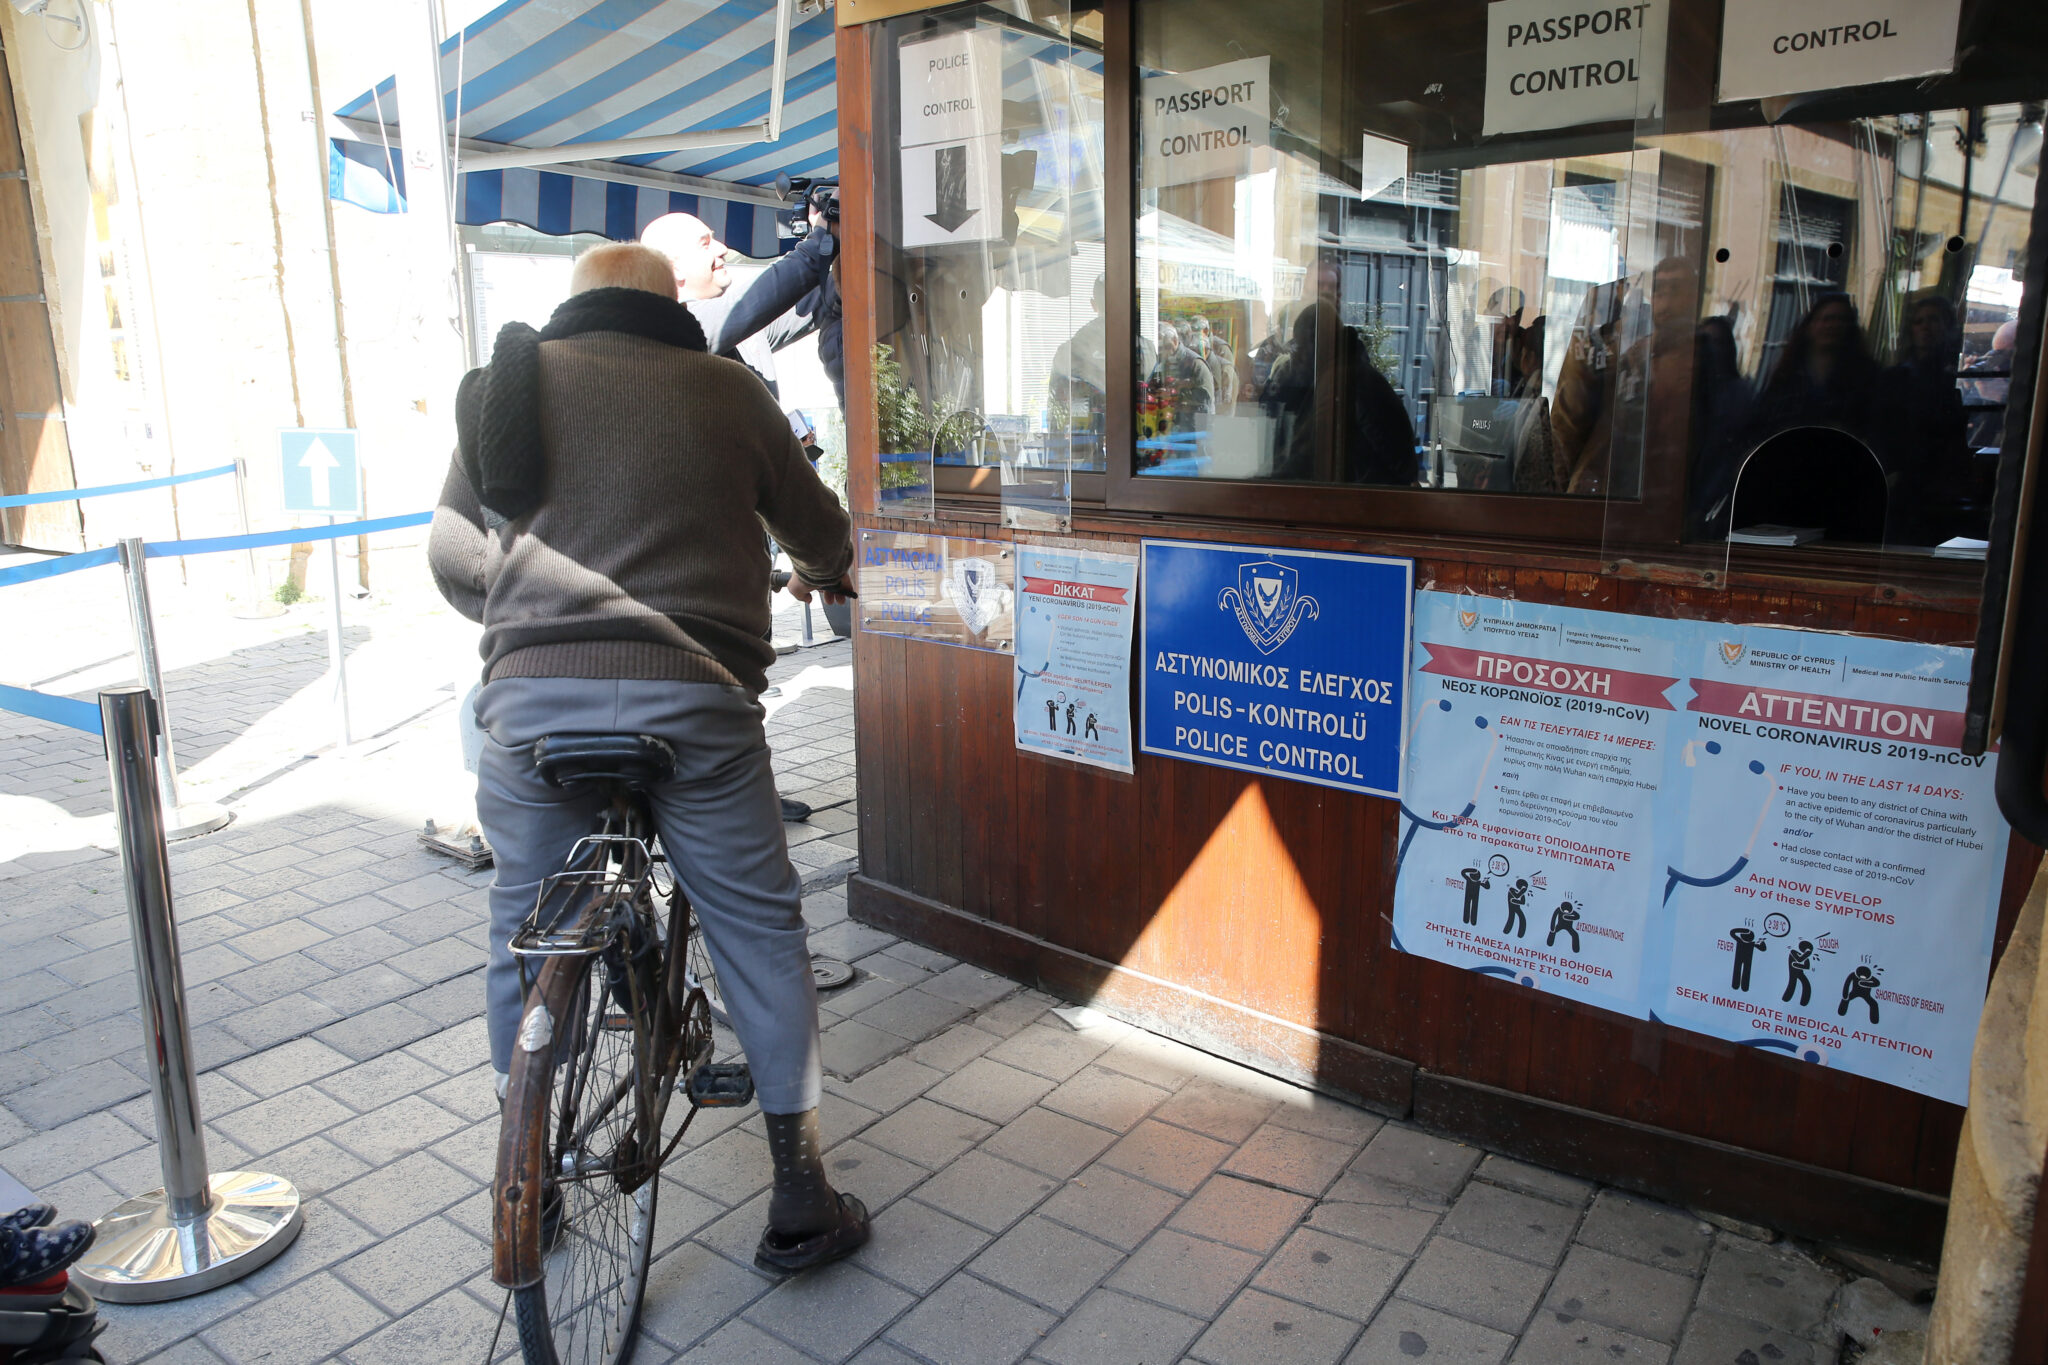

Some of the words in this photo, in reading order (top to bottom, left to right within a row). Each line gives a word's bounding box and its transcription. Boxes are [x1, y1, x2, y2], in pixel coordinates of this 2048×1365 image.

[1508, 4, 1650, 47] PASSPORT
[1773, 19, 1898, 54] CONTROL
[930, 53, 968, 72] POLICE
[1510, 58, 1640, 96] CONTROL
[924, 98, 976, 117] CONTROL
[1155, 81, 1255, 116] PASSPORT
[1160, 126, 1251, 157] CONTROL
[864, 546, 944, 573] ΑΣΤΥΝΟΜΙΑ
[1053, 582, 1095, 599] DİKKAT
[881, 601, 932, 626] POLICE
[1483, 617, 1514, 626] ΚΥΠΡΙΑΚΗ
[1515, 621, 1556, 632] ΔΗΜΟΚΡΑΤΙΑ
[1483, 626, 1516, 636] ΥΠΟΥΡΓΕΙΟ
[1517, 630, 1539, 638] ΥΓΕΙΑΣ
[1749, 660, 1786, 669] MINISTRY
[1800, 665, 1830, 675] HEALTH
[1750, 649, 1788, 660] REPUBLIC
[1803, 655, 1835, 665] CYPRUS
[1156, 652, 1290, 689] ΑΣΤΥΝΟΜΙΚΟΣ
[1300, 670, 1393, 704] ΕΛΕΓΧΟΣ
[1475, 655, 1610, 695] ΠΡΟΣΟΧΗ
[1852, 667, 1878, 675] Medical
[1894, 672, 1916, 680] Public
[1918, 675, 1941, 683] Health
[1441, 678, 1476, 694] ΝΕΟΣ
[1480, 684, 1562, 708] ΚΟΡΩΝΟΪΟΣ
[1565, 698, 1649, 724] (2019-nCoV)
[1737, 691, 1934, 739] ATTENTION
[1499, 715, 1521, 726] ΕΑΝ
[1523, 719, 1538, 730] ΤΙΣ
[1540, 722, 1600, 740] ΤΕΛΕΥΤΑΙΕΣ
[1603, 733, 1614, 742] 14
[1615, 735, 1656, 750] ΜΕΡΕΣ:
[1698, 716, 1751, 735] NOVEL
[1755, 725, 1881, 754] CORONAVIRUS
[1886, 744, 1986, 767] 2019-nCoV
[1175, 726, 1248, 758] POLICE
[1259, 740, 1364, 779] CONTROL
[1562, 766, 1586, 777] Wuhan
[1635, 780, 1657, 790] Hubei
[1779, 763, 1792, 773] IF
[1794, 765, 1821, 780] YOU,
[1824, 770, 1838, 781] IN
[1842, 772, 1866, 786] THE
[1868, 777, 1903, 791] LAST
[1906, 783, 1920, 793] 14
[1923, 785, 1964, 800] DAYS:
[1786, 785, 1808, 796] Have
[1809, 791, 1825, 799] you
[1826, 791, 1848, 802] been
[1850, 796, 1859, 804] to
[1860, 799, 1876, 809] any
[1878, 800, 1907, 812] district
[1920, 807, 1946, 818] China
[1948, 812, 1968, 821] with
[1797, 801, 1822, 811] active
[1823, 805, 1862, 817] epidemic
[1873, 814, 1924, 828] coronavirus
[1926, 822, 1976, 837] particularly
[1431, 810, 1448, 821] Και
[1449, 813, 1479, 828] ΤΩΡΑ
[1544, 834, 1630, 861] ΟΠΟΙΟΔΗΠΟΤΕ
[1534, 813, 1571, 828] 2019-nCoV
[1782, 827, 1813, 838] and/or
[1784, 810, 1792, 818] to
[1794, 811, 1807, 820] the
[1808, 814, 1823, 824] city
[1835, 818, 1865, 830] Wuhan
[1866, 825, 1895, 835] and/or
[1896, 829, 1910, 838] the
[1912, 832, 1942, 844] district
[1944, 837, 1954, 845] of
[1955, 838, 1983, 850] Hubei
[1466, 831, 1477, 840] τα
[1536, 845, 1614, 871] ΣΥΜΠΤΩΜΑΤΑ
[1780, 842, 1797, 852] Had
[1799, 846, 1821, 856] close
[1822, 851, 1853, 862] contact
[1854, 856, 1872, 866] with
[1881, 862, 1925, 875] confirmed
[1789, 857, 1831, 870] suspected
[1832, 865, 1853, 875] case
[1854, 868, 1864, 876] of
[1864, 870, 1914, 886] 2019-nCoV
[1733, 885, 1756, 898] any
[1759, 890, 1773, 899] of
[1776, 892, 1810, 907] these
[1814, 900, 1894, 924] SYMPTOMS
[1748, 872, 1774, 886] And
[1778, 878, 1811, 893] NOW
[1814, 885, 1882, 906] DEVELOP
[1425, 921, 1471, 941] ΖΗΤΗΣΤΕ
[1473, 935, 1510, 952] ΑΜΕΣΑ
[1513, 945, 1556, 964] ΙΑΤΡΙΚΗ
[1559, 957, 1612, 979] ΒΟΗΘΕΙΑ
[1717, 939, 1734, 952] FEVER
[1819, 938, 1839, 949] COUGH
[1456, 940, 1536, 970] ΤΗΛΕΦΩΝΗΣΤΕ
[1538, 964, 1560, 977] ΣΤΟ
[1564, 971, 1588, 984] 1420
[1874, 988, 1910, 1006] SHORTNESS
[1910, 996, 1919, 1007] OF
[1919, 998, 1944, 1014] BREATH
[1675, 986, 1708, 1002] SEEK
[1711, 995, 1782, 1021] IMMEDIATE
[1786, 1014, 1848, 1037] MEDICAL
[1850, 1030, 1932, 1059] ATTENTION
[1751, 1018, 1770, 1031] OR
[1774, 1024, 1807, 1040] RING
[1812, 1034, 1841, 1049] 1420
